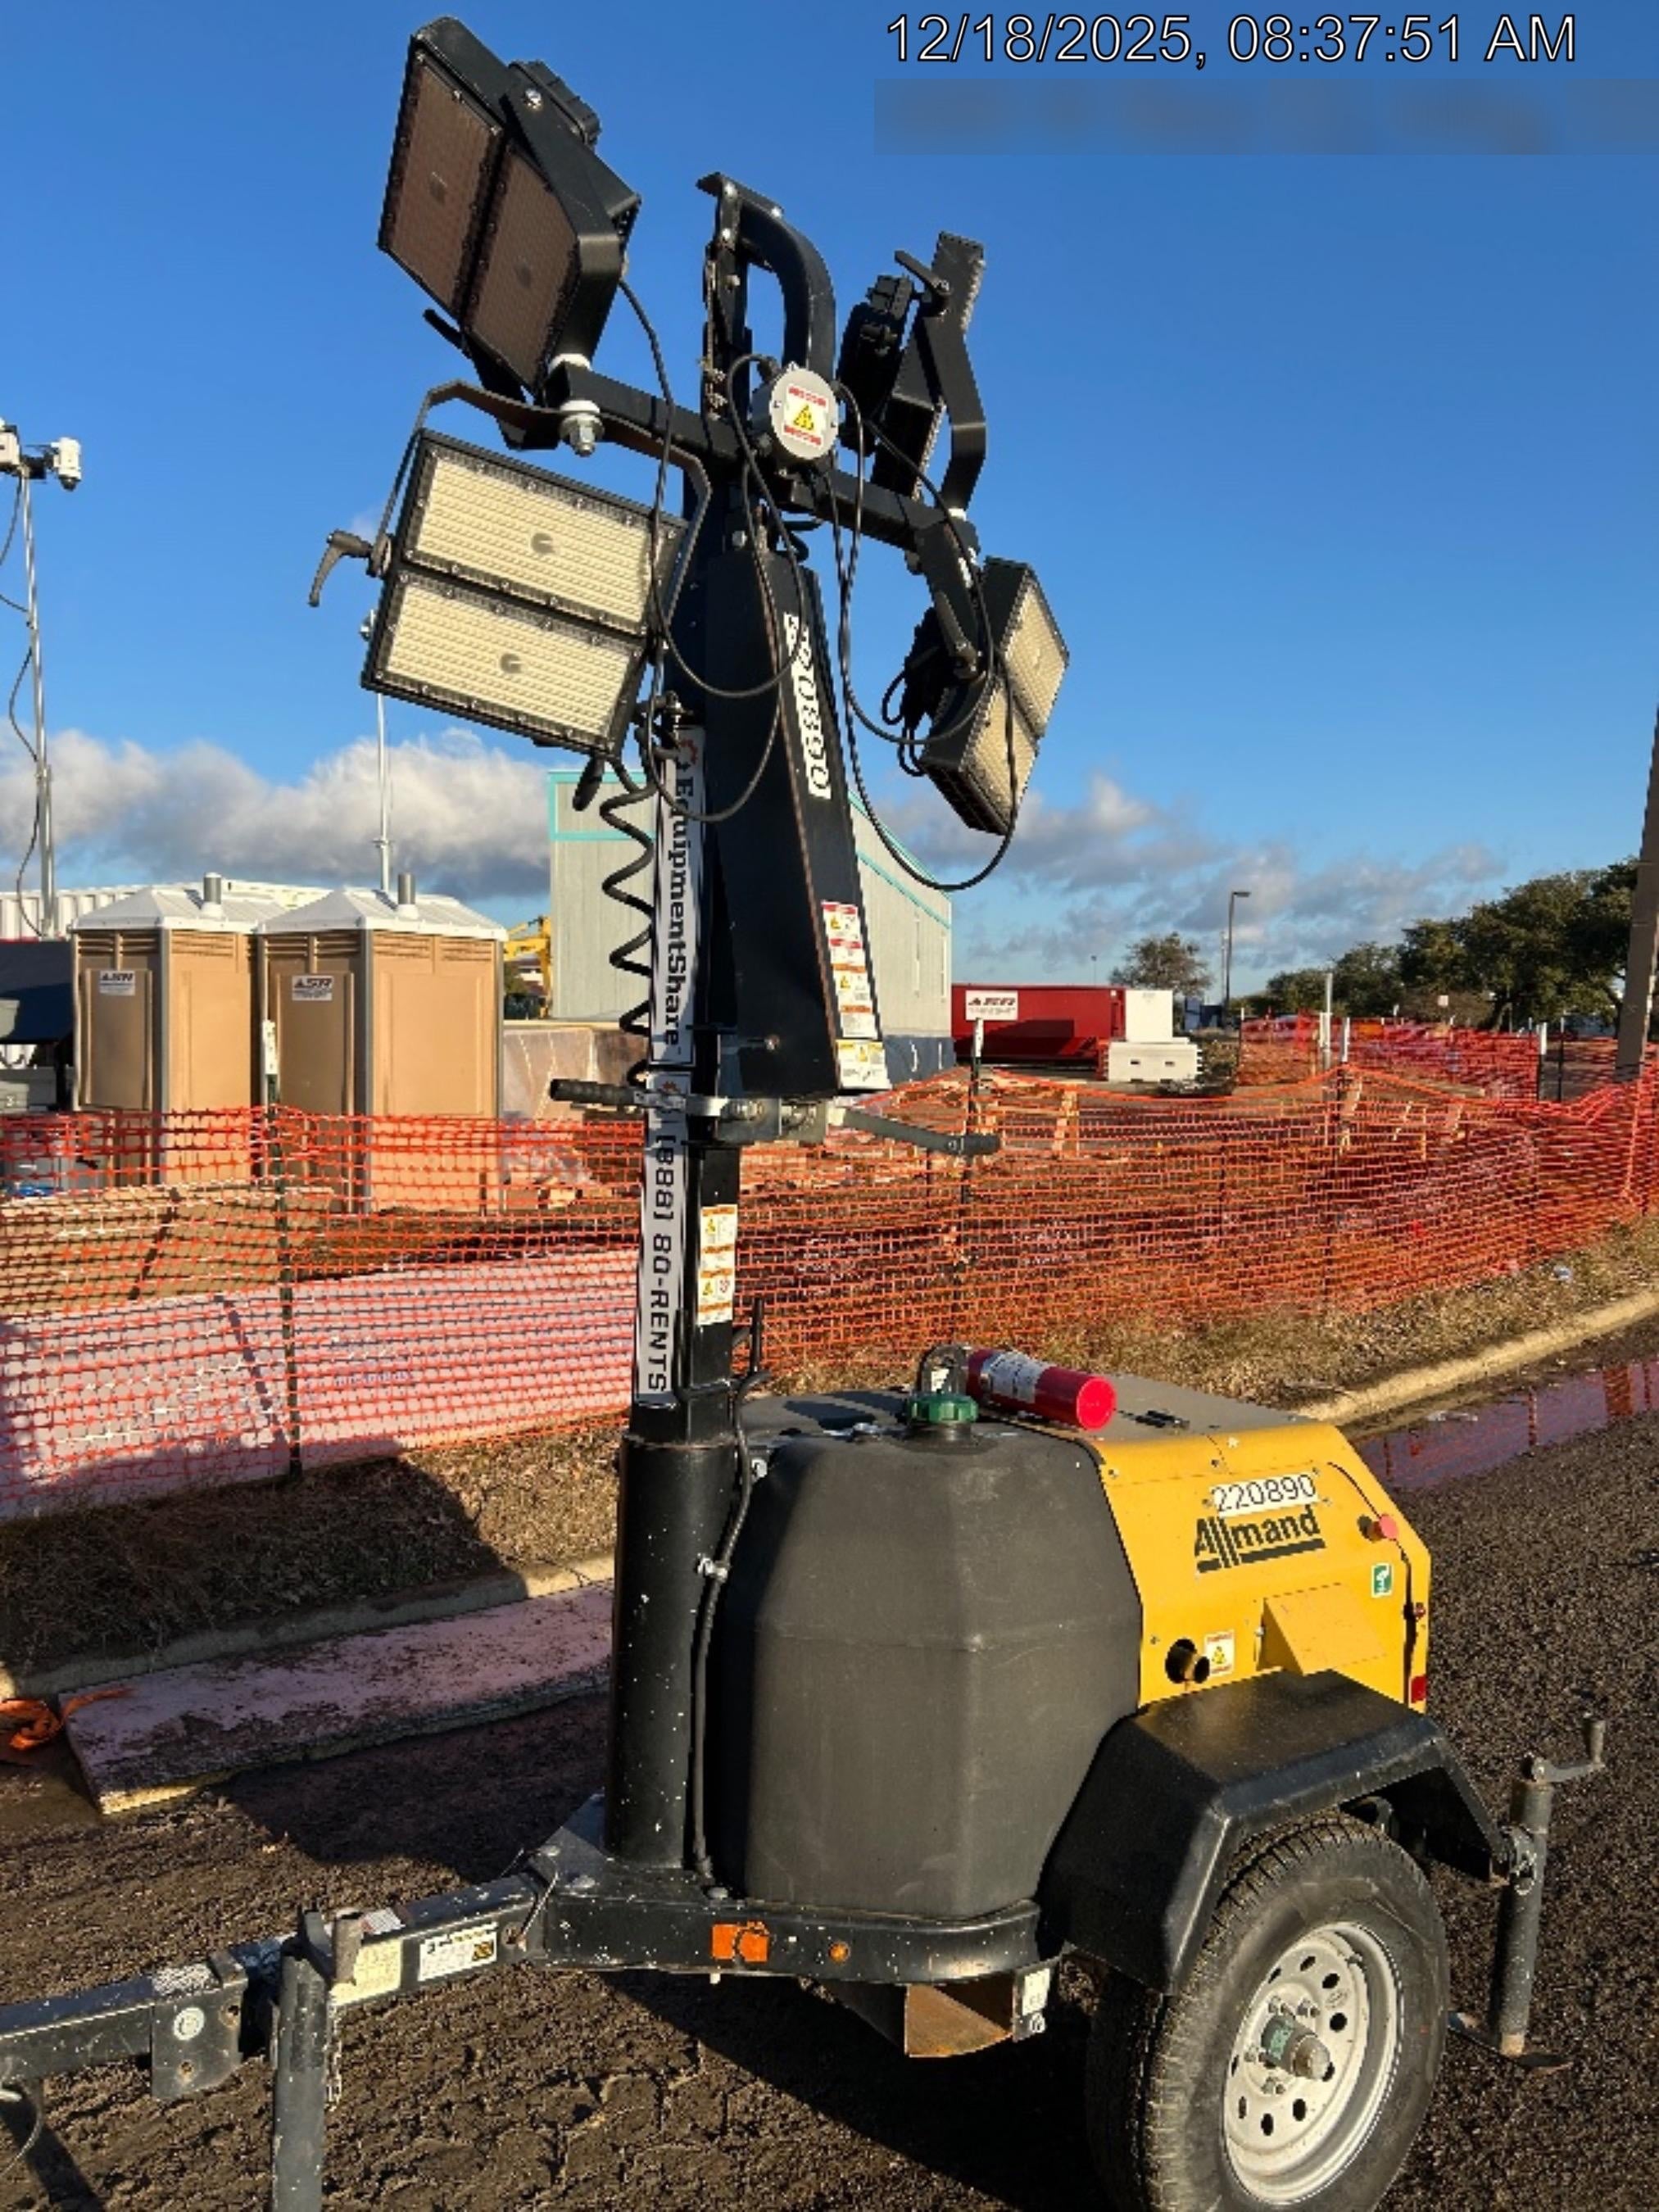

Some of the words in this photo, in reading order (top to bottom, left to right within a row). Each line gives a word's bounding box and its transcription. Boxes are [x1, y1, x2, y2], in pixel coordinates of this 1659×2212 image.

[647, 1234, 673, 1392] 80-RENTS
[1212, 1475, 1316, 1512] 220890
[1194, 1504, 1321, 1569] Allmand
